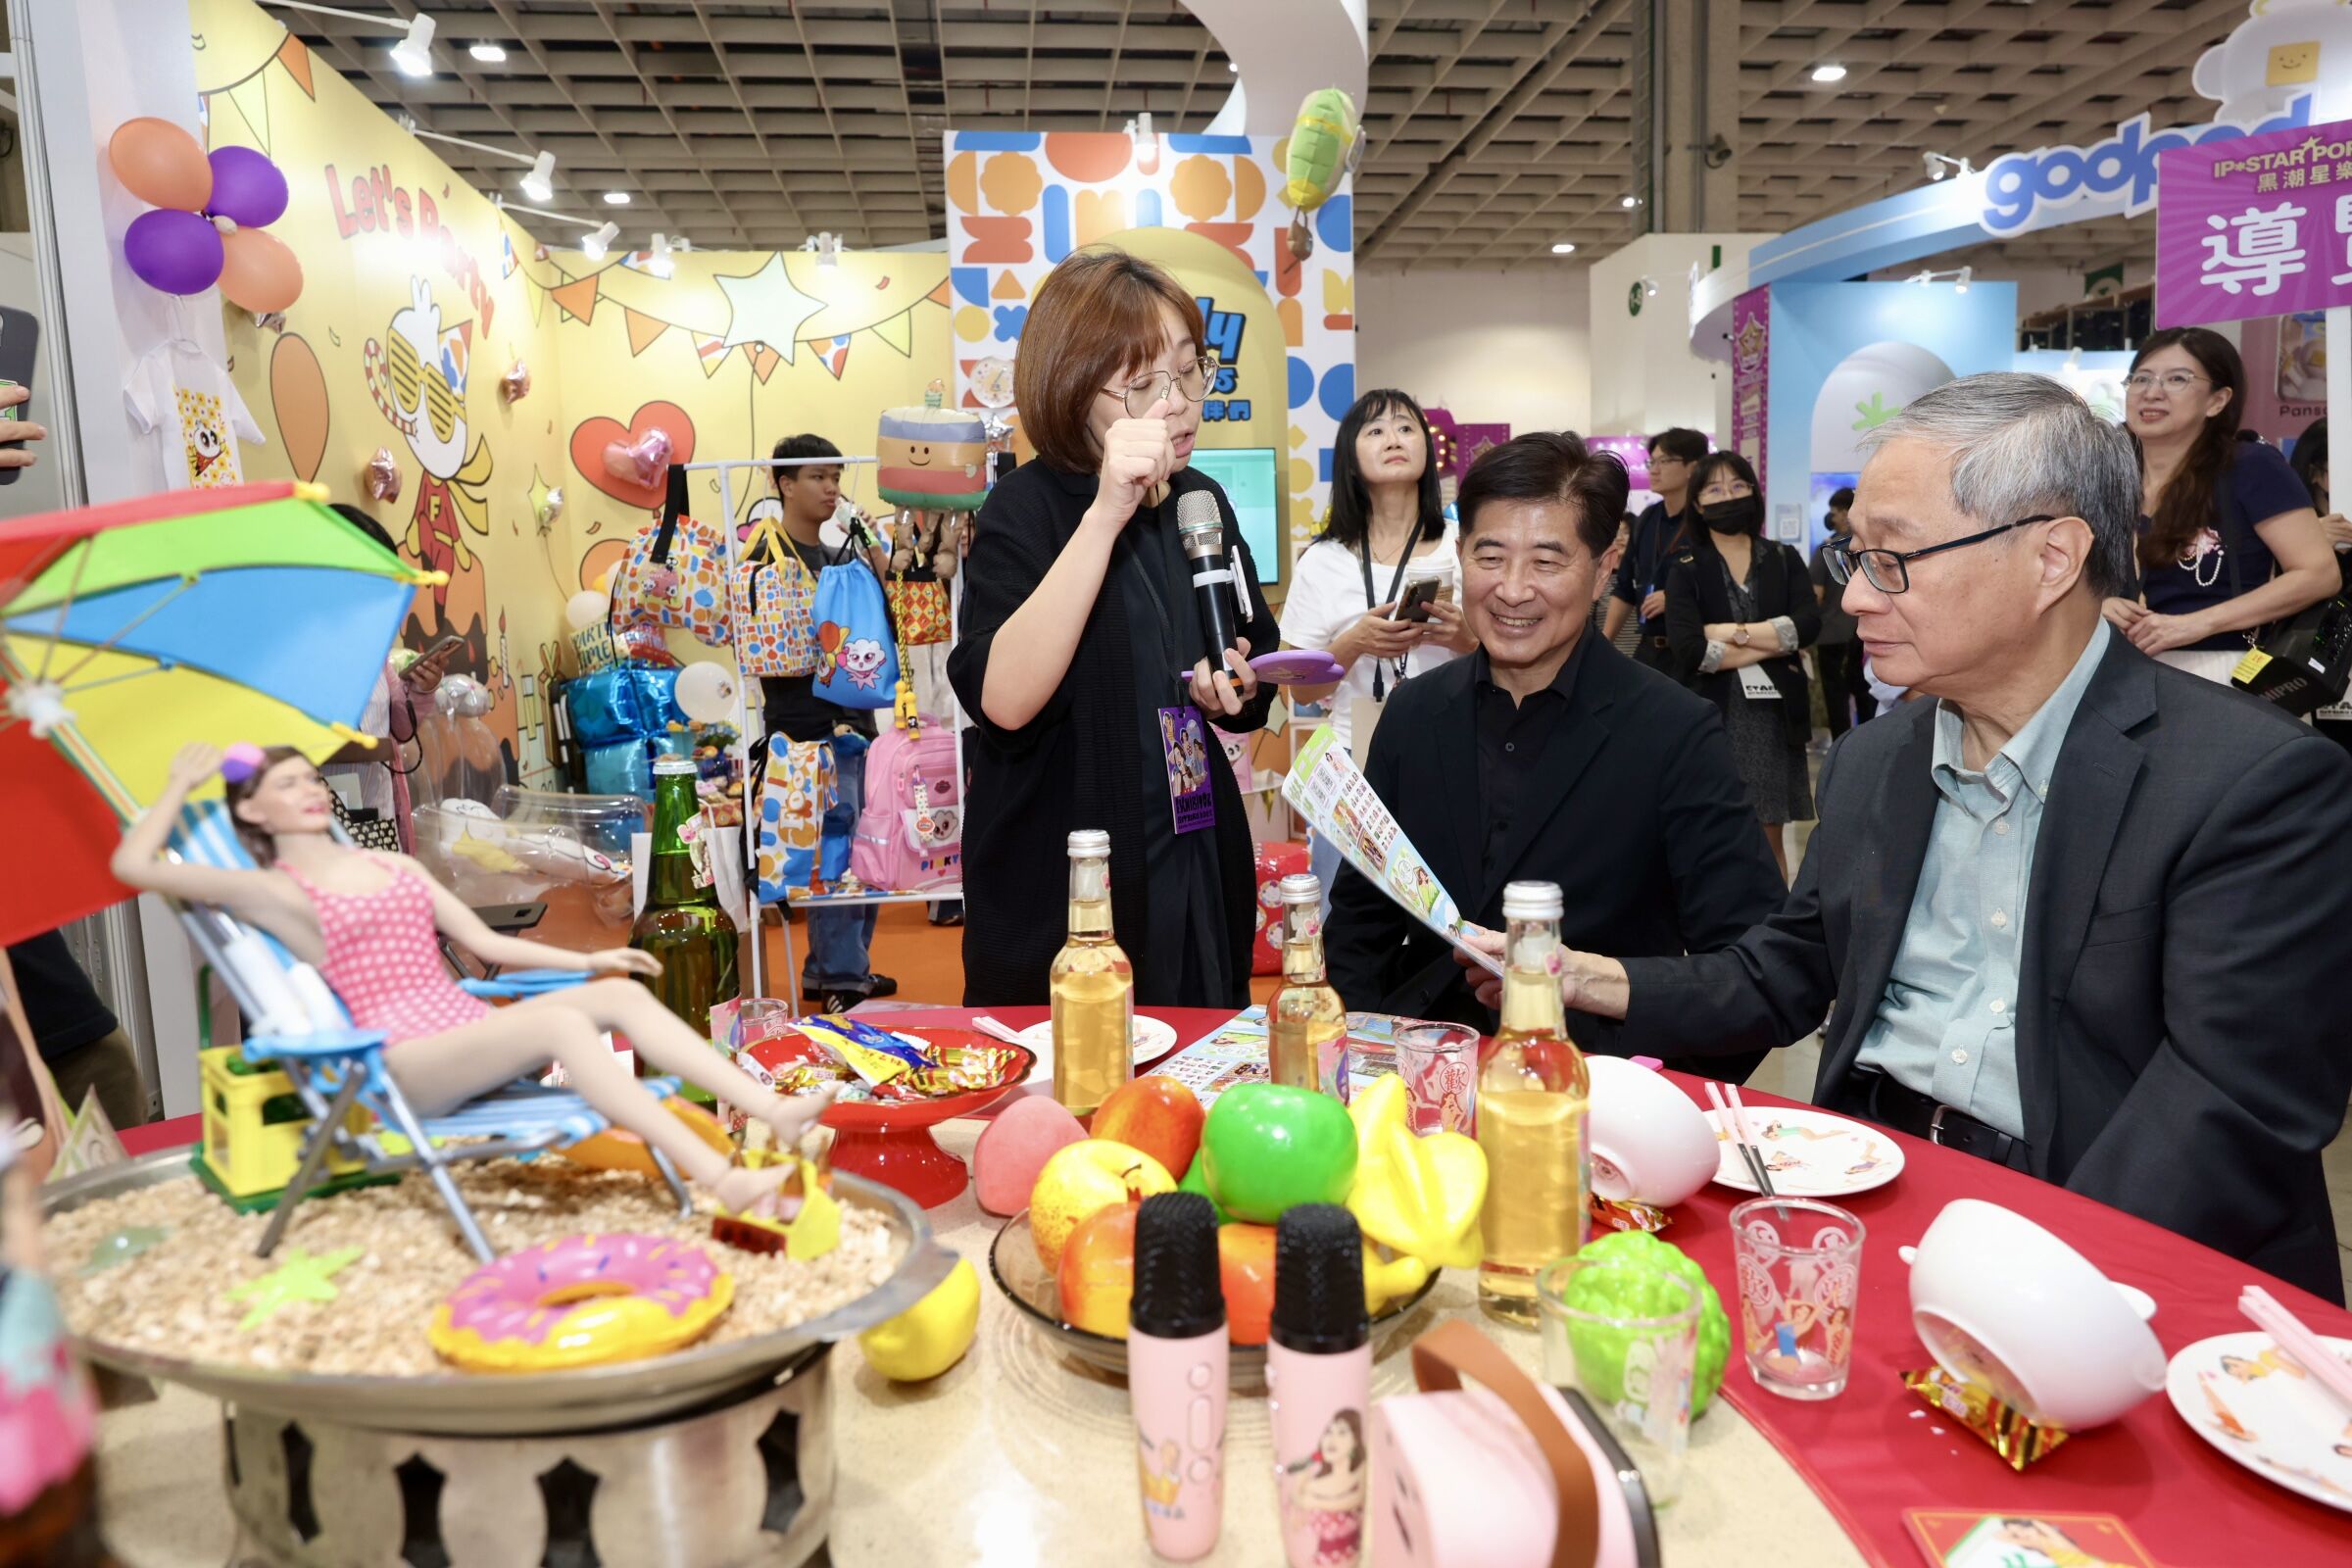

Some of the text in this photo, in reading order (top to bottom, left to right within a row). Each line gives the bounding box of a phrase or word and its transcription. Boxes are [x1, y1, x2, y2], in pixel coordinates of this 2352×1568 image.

[324, 164, 414, 239] Let's
[2200, 194, 2352, 297] 導
[921, 854, 959, 870] PINKY
